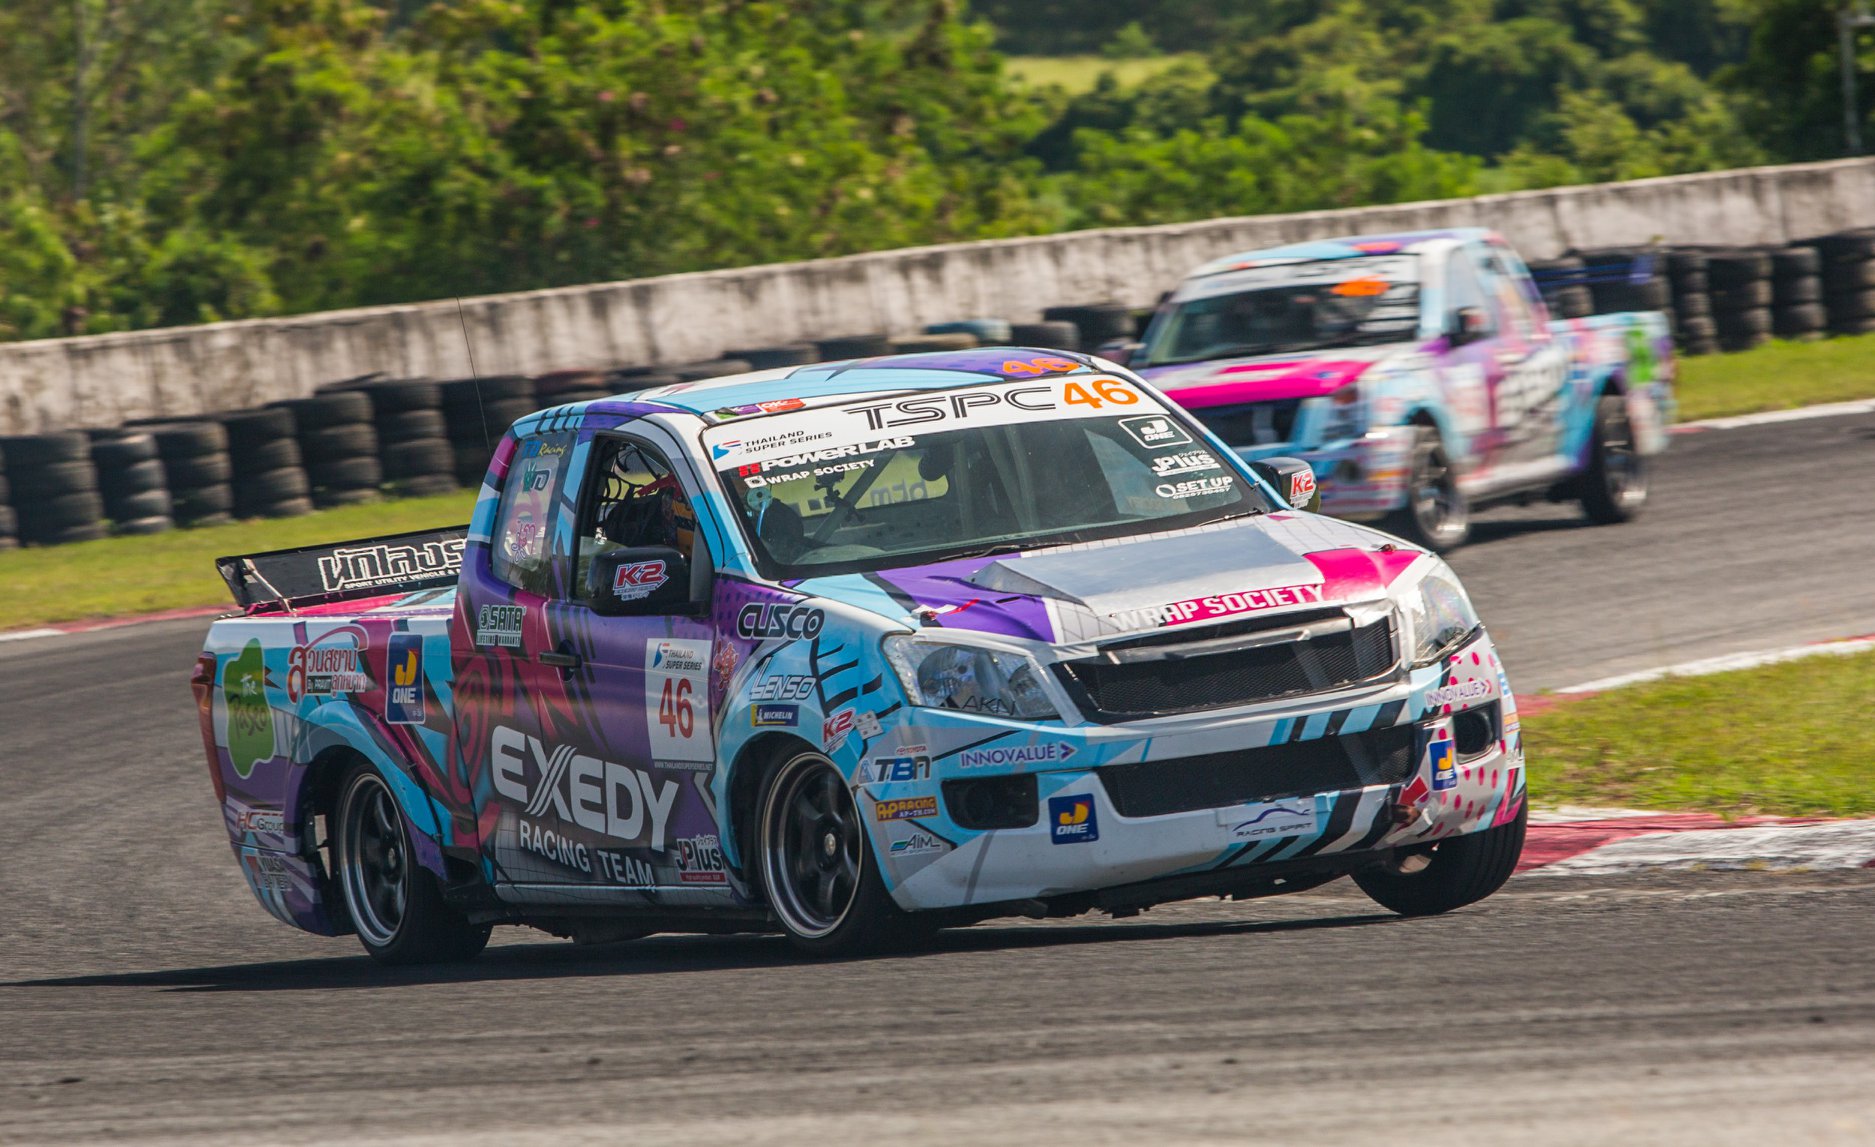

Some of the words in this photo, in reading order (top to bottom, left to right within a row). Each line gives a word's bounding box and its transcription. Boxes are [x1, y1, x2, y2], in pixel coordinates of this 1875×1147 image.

[1003, 358, 1079, 375] 46
[843, 387, 1056, 430] TSPC
[1063, 379, 1139, 409] 46
[746, 430, 804, 447] THAILAND
[746, 439, 786, 454] SUPER
[789, 431, 833, 447] SERIES
[1144, 431, 1175, 442] ONE
[766, 472, 810, 485] WRAP
[813, 459, 875, 477] SOCIETY
[1176, 478, 1209, 493] SET
[1211, 475, 1233, 489] UP
[1292, 472, 1315, 496] K2
[344, 580, 373, 590] SPORT
[375, 576, 408, 585] UTILITY
[410, 570, 446, 580] VEHICLE
[615, 562, 665, 588] K2
[489, 606, 522, 631] SATA
[1110, 600, 1199, 631] WRAP
[1203, 584, 1324, 615] SOCIETY
[737, 602, 825, 640] CUSCO
[668, 649, 693, 659] THAILAND
[665, 661, 682, 670] SUPER
[683, 661, 702, 671] SERIES
[750, 656, 816, 700] LENSO
[392, 688, 416, 704] ONE
[659, 677, 694, 738] 46
[763, 711, 793, 720] MICHELIN
[823, 710, 853, 743] K2
[492, 725, 679, 852] EXEDY
[899, 798, 934, 810] RACING
[1056, 823, 1088, 836] ONE
[1236, 827, 1277, 837] RACING
[519, 819, 591, 873] RACING
[598, 849, 656, 892] TEAM
